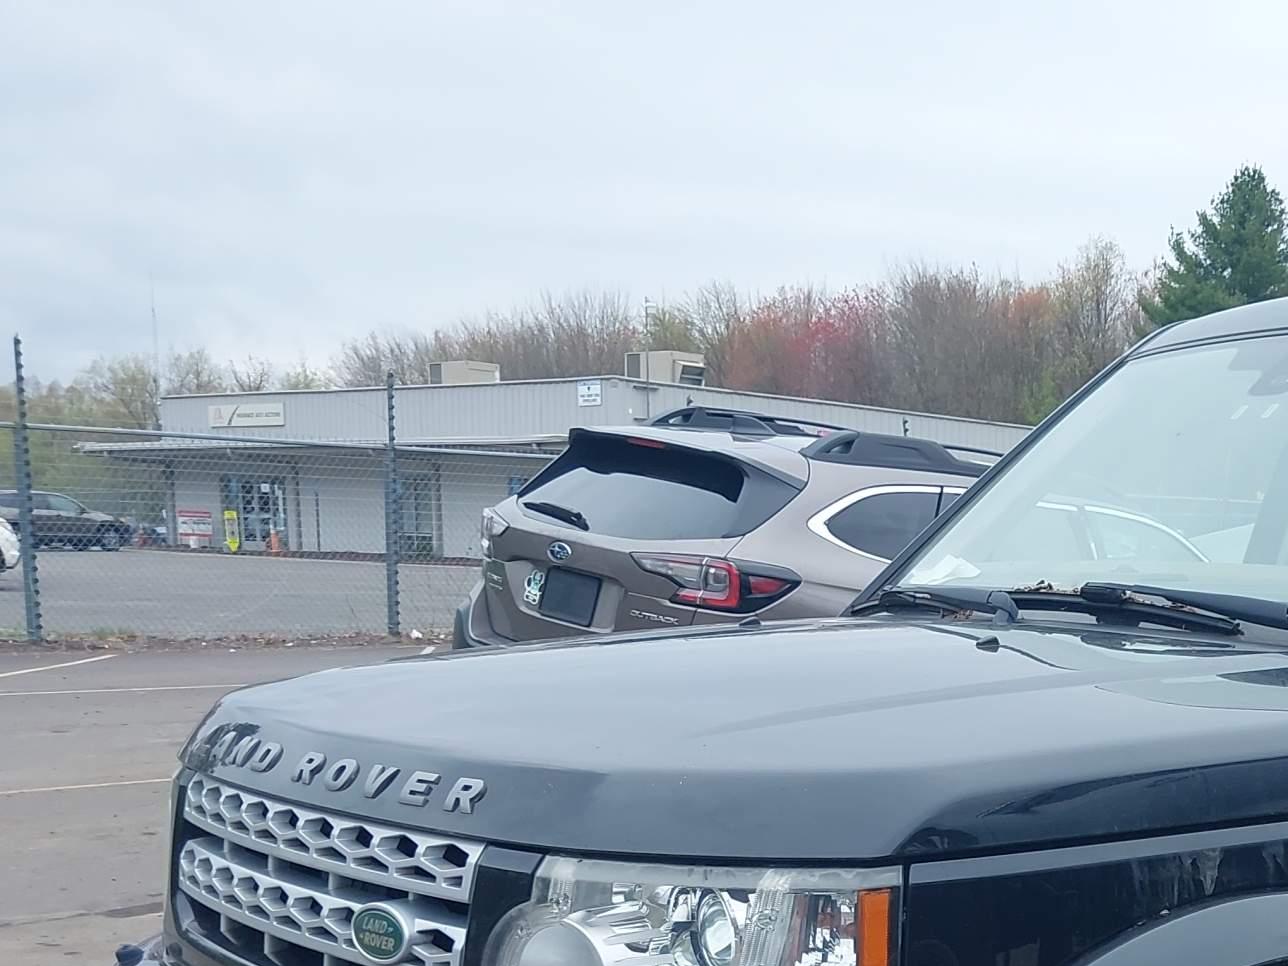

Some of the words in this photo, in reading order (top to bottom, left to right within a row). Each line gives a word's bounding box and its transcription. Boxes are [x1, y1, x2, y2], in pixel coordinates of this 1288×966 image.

[291, 751, 488, 814] ROVER
[362, 916, 389, 934] LAND
[363, 932, 396, 953] ROVER
